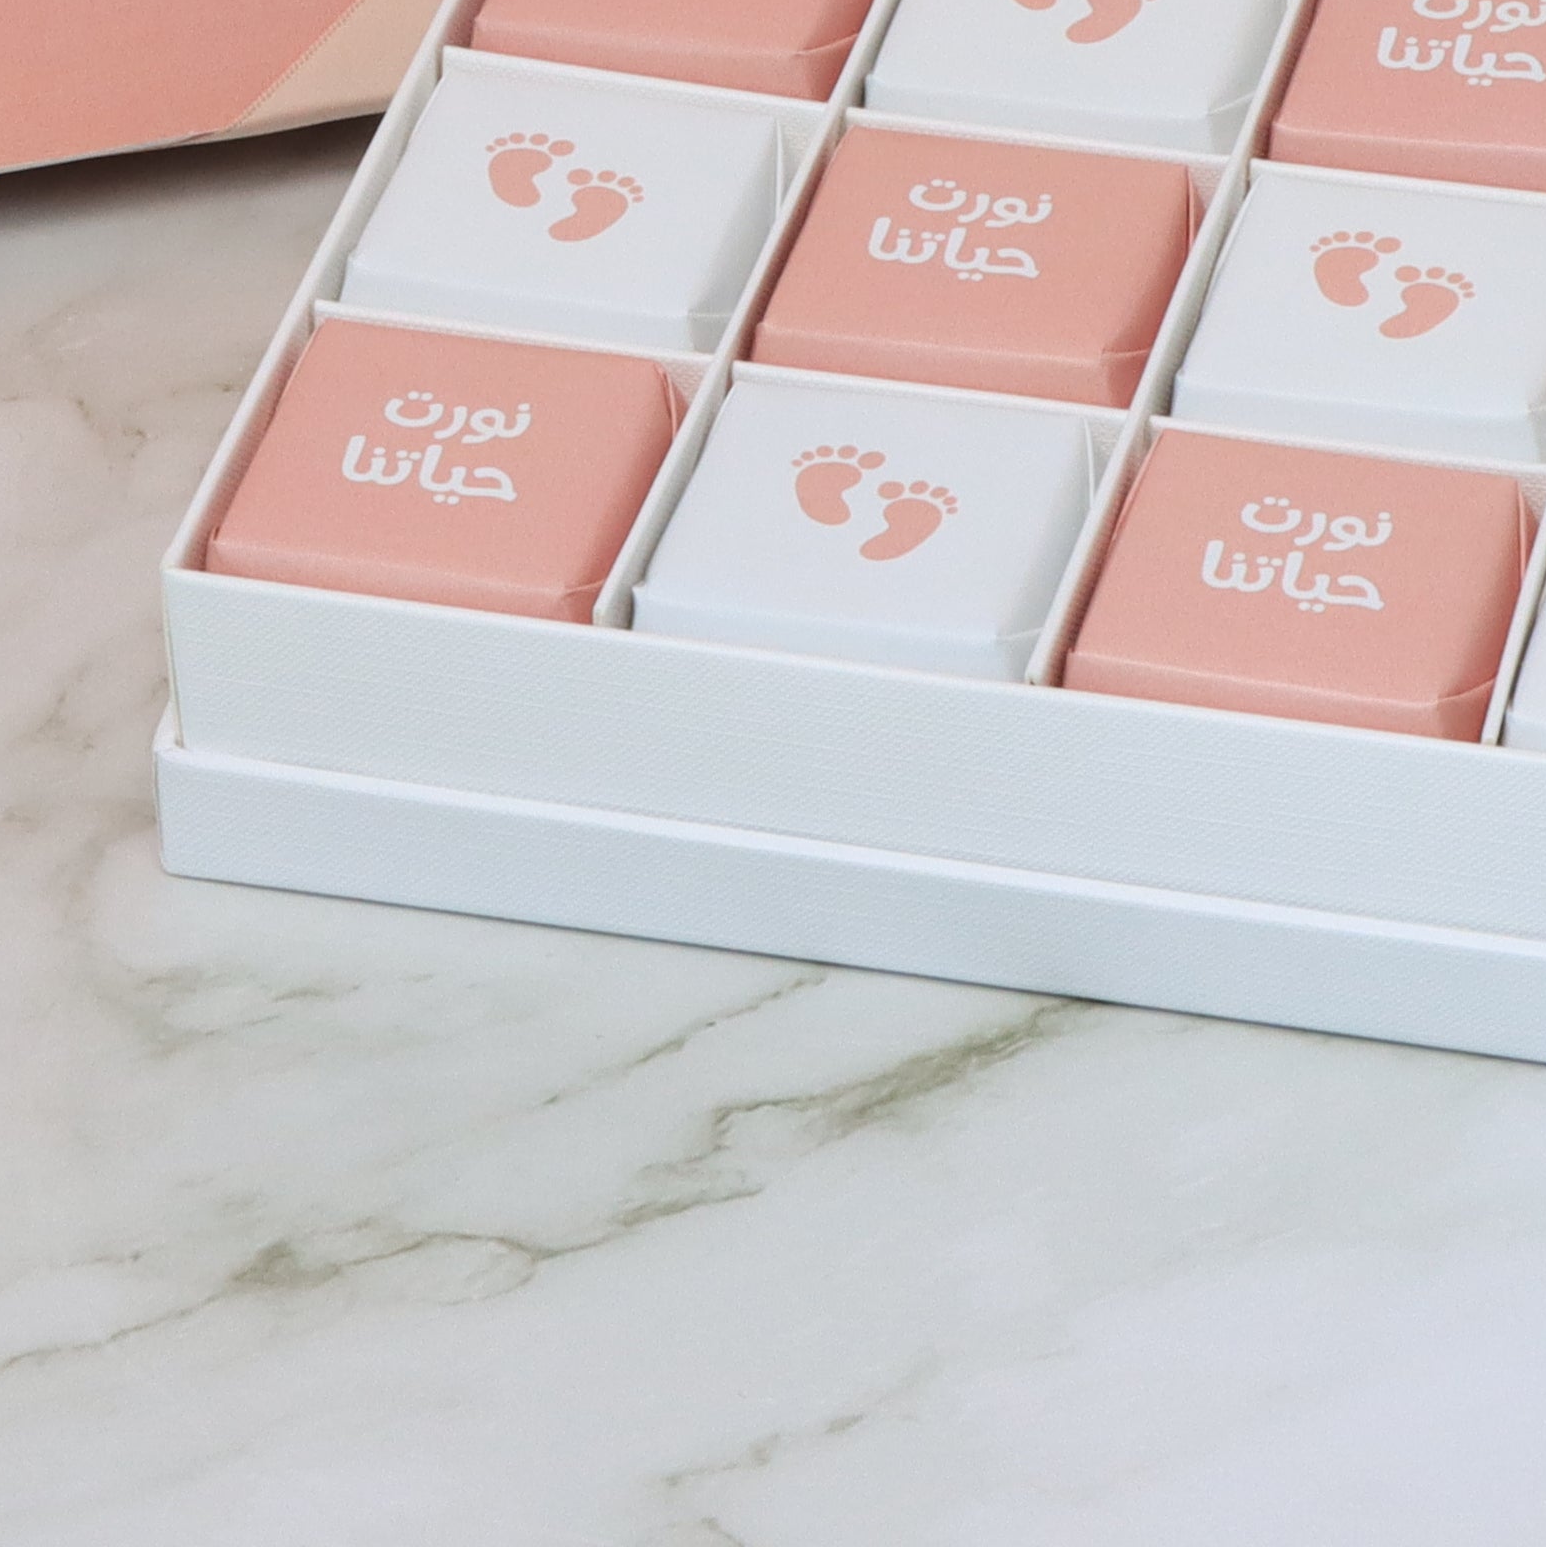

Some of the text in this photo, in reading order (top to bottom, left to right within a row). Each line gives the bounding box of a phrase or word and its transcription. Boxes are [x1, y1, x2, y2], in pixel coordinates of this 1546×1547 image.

[908, 179, 1053, 228] نورت
[868, 216, 1040, 281] حياتنا
[384, 391, 533, 444] نورت
[341, 434, 517, 505] حياتنا
[1241, 496, 1393, 552] نورت
[1201, 539, 1385, 613] حياتنا
